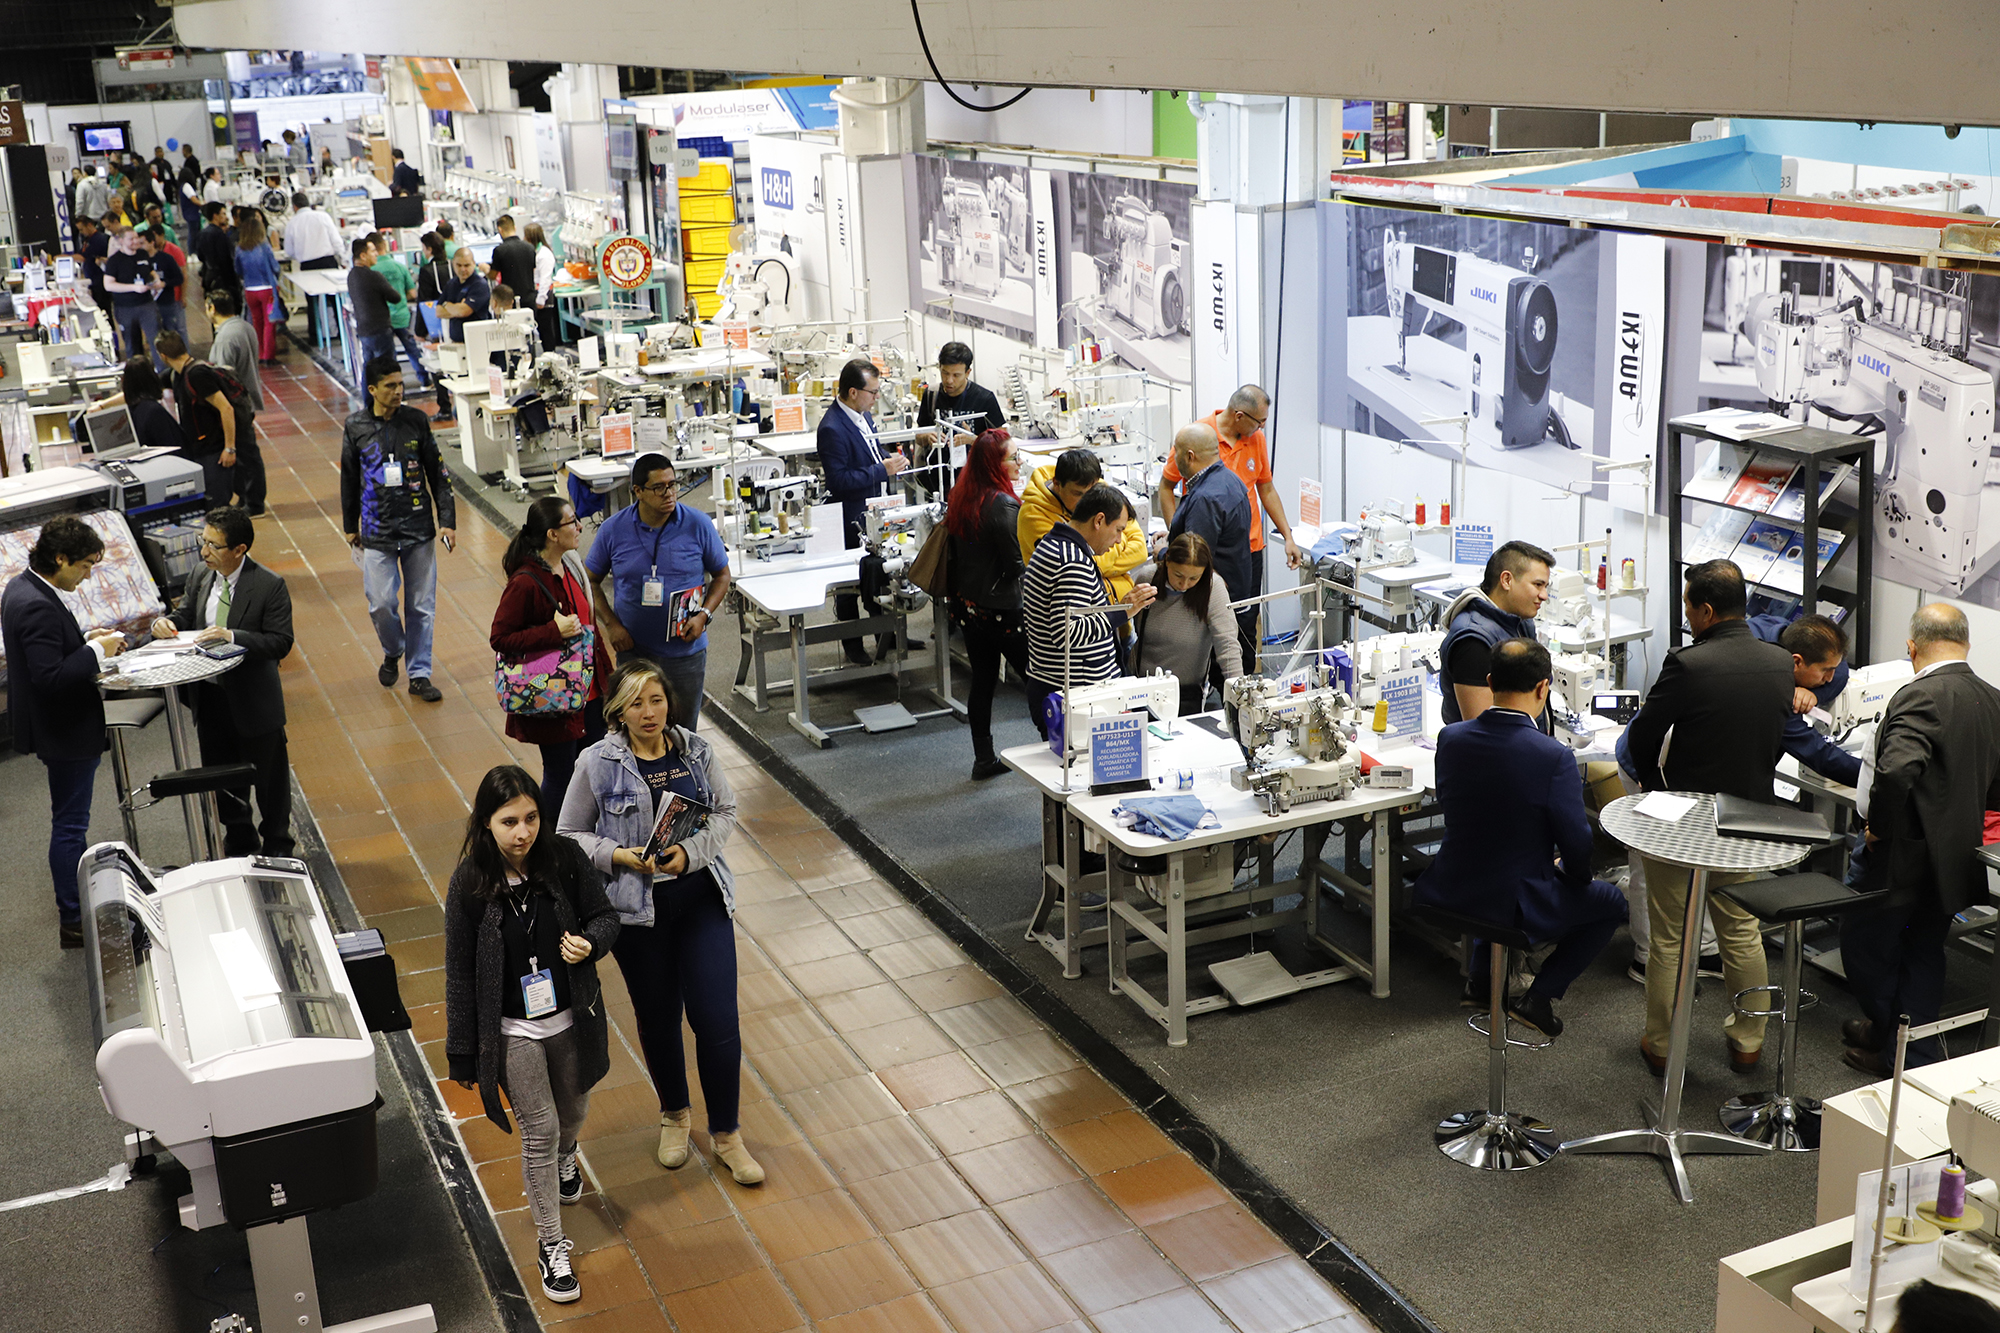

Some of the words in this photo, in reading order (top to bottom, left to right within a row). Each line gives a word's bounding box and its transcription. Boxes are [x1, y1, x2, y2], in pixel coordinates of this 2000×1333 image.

[690, 102, 771, 116] Modulaser
[655, 146, 668, 154] 140
[51, 155, 65, 164] 137
[681, 159, 695, 167] 239
[1780, 176, 1791, 189] 33
[763, 172, 792, 206] H&H
[1037, 220, 1047, 278] AMEXI
[1212, 262, 1224, 332] AMEXI
[1470, 287, 1497, 304] JUKI
[1619, 311, 1640, 401] AMEXI
[1857, 354, 1891, 377] JUKI
[1455, 524, 1492, 533] JUKI
[1381, 675, 1420, 691] JUKI
[1394, 690, 1408, 698] 1903
[1409, 687, 1418, 695] BN
[1863, 694, 1884, 703] JUKI
[1092, 719, 1139, 733] JUKI
[1100, 746, 1134, 754] RECUBRIDORA
[1096, 751, 1139, 761] DOBLADILLADORA
[654, 768, 680, 779] CHOCES
[1103, 764, 1125, 772] MANGAS
[670, 770, 690, 780] TORIES
[1105, 770, 1131, 778] CAMISETA
